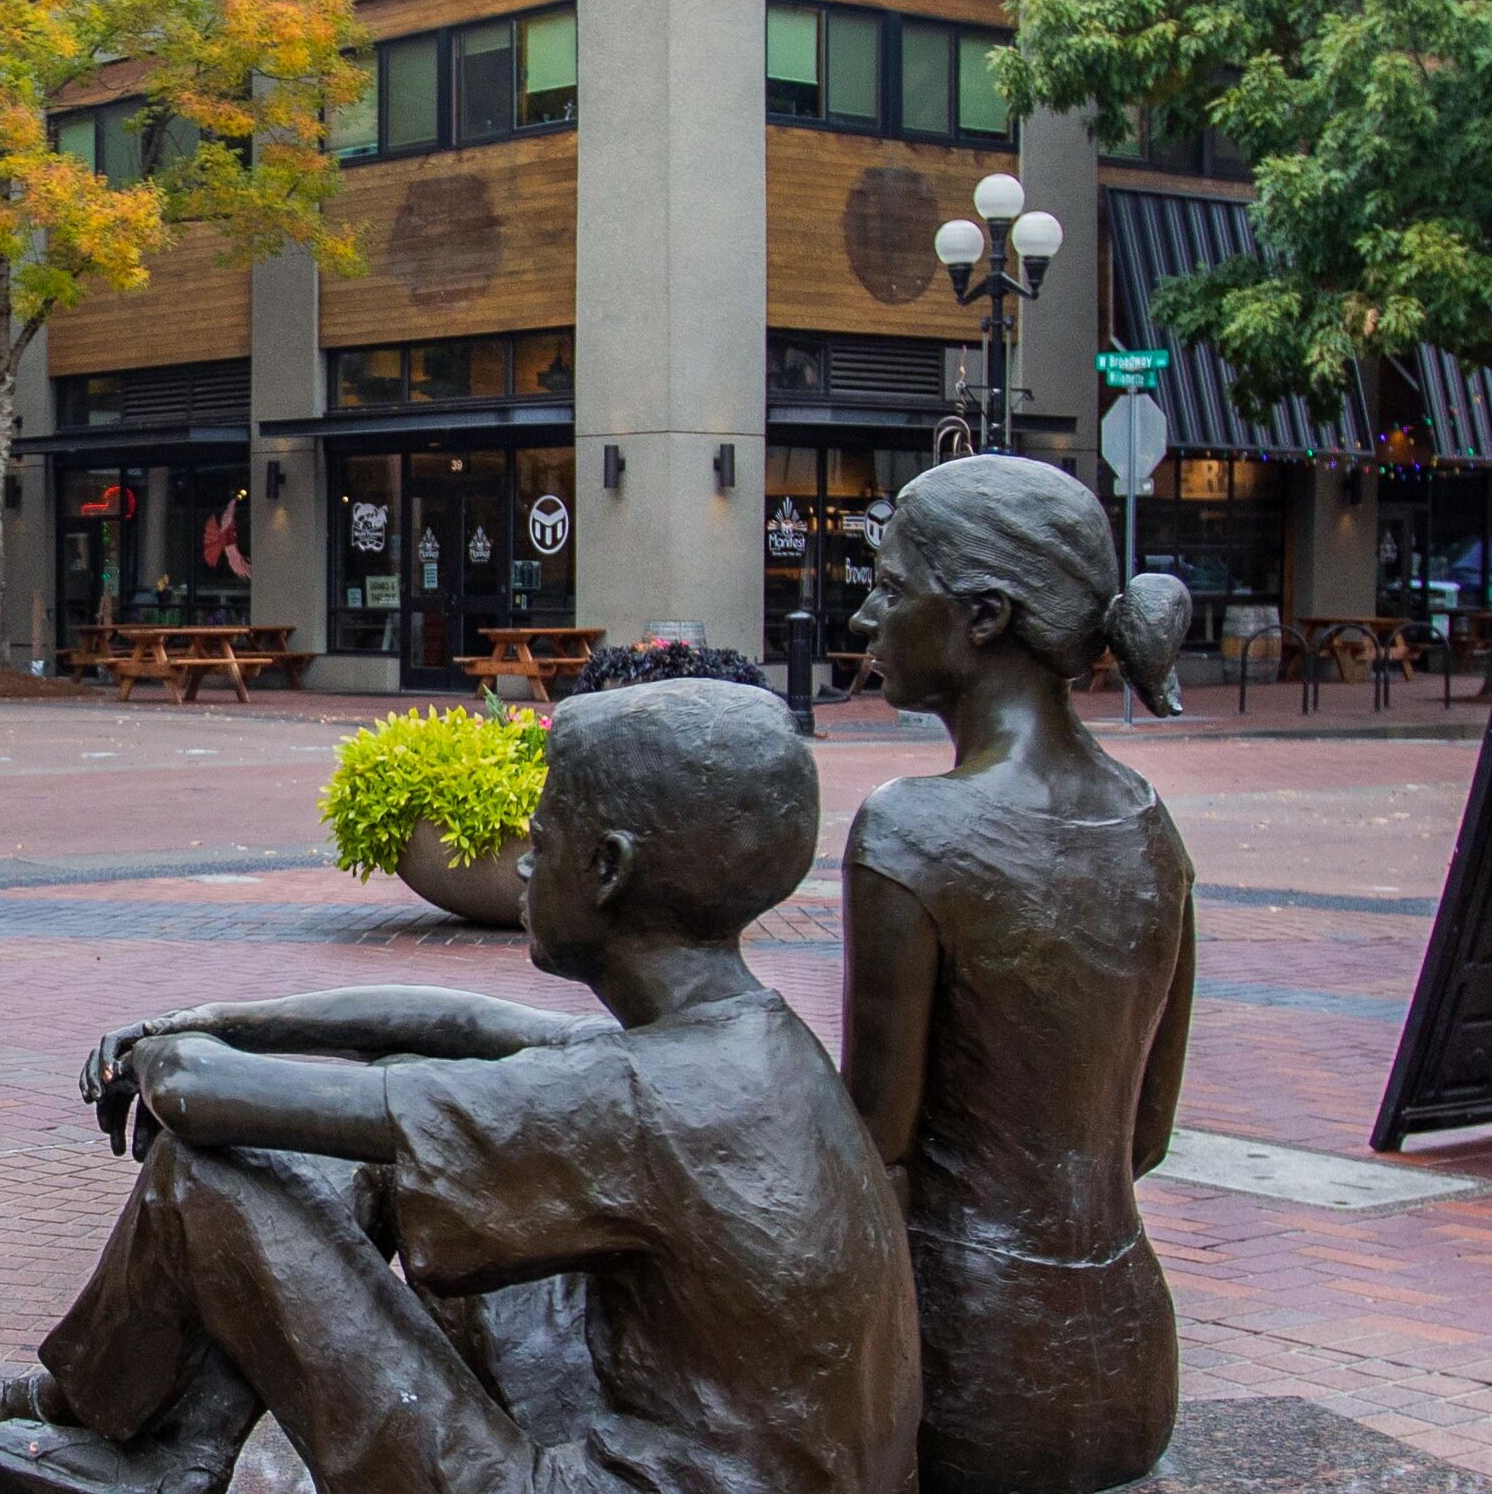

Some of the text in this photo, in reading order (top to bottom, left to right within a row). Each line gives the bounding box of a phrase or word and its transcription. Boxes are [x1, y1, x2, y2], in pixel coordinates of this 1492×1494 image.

[1109, 353, 1153, 369] Broadway
[451, 459, 463, 471] 39
[768, 532, 806, 551] Manifest
